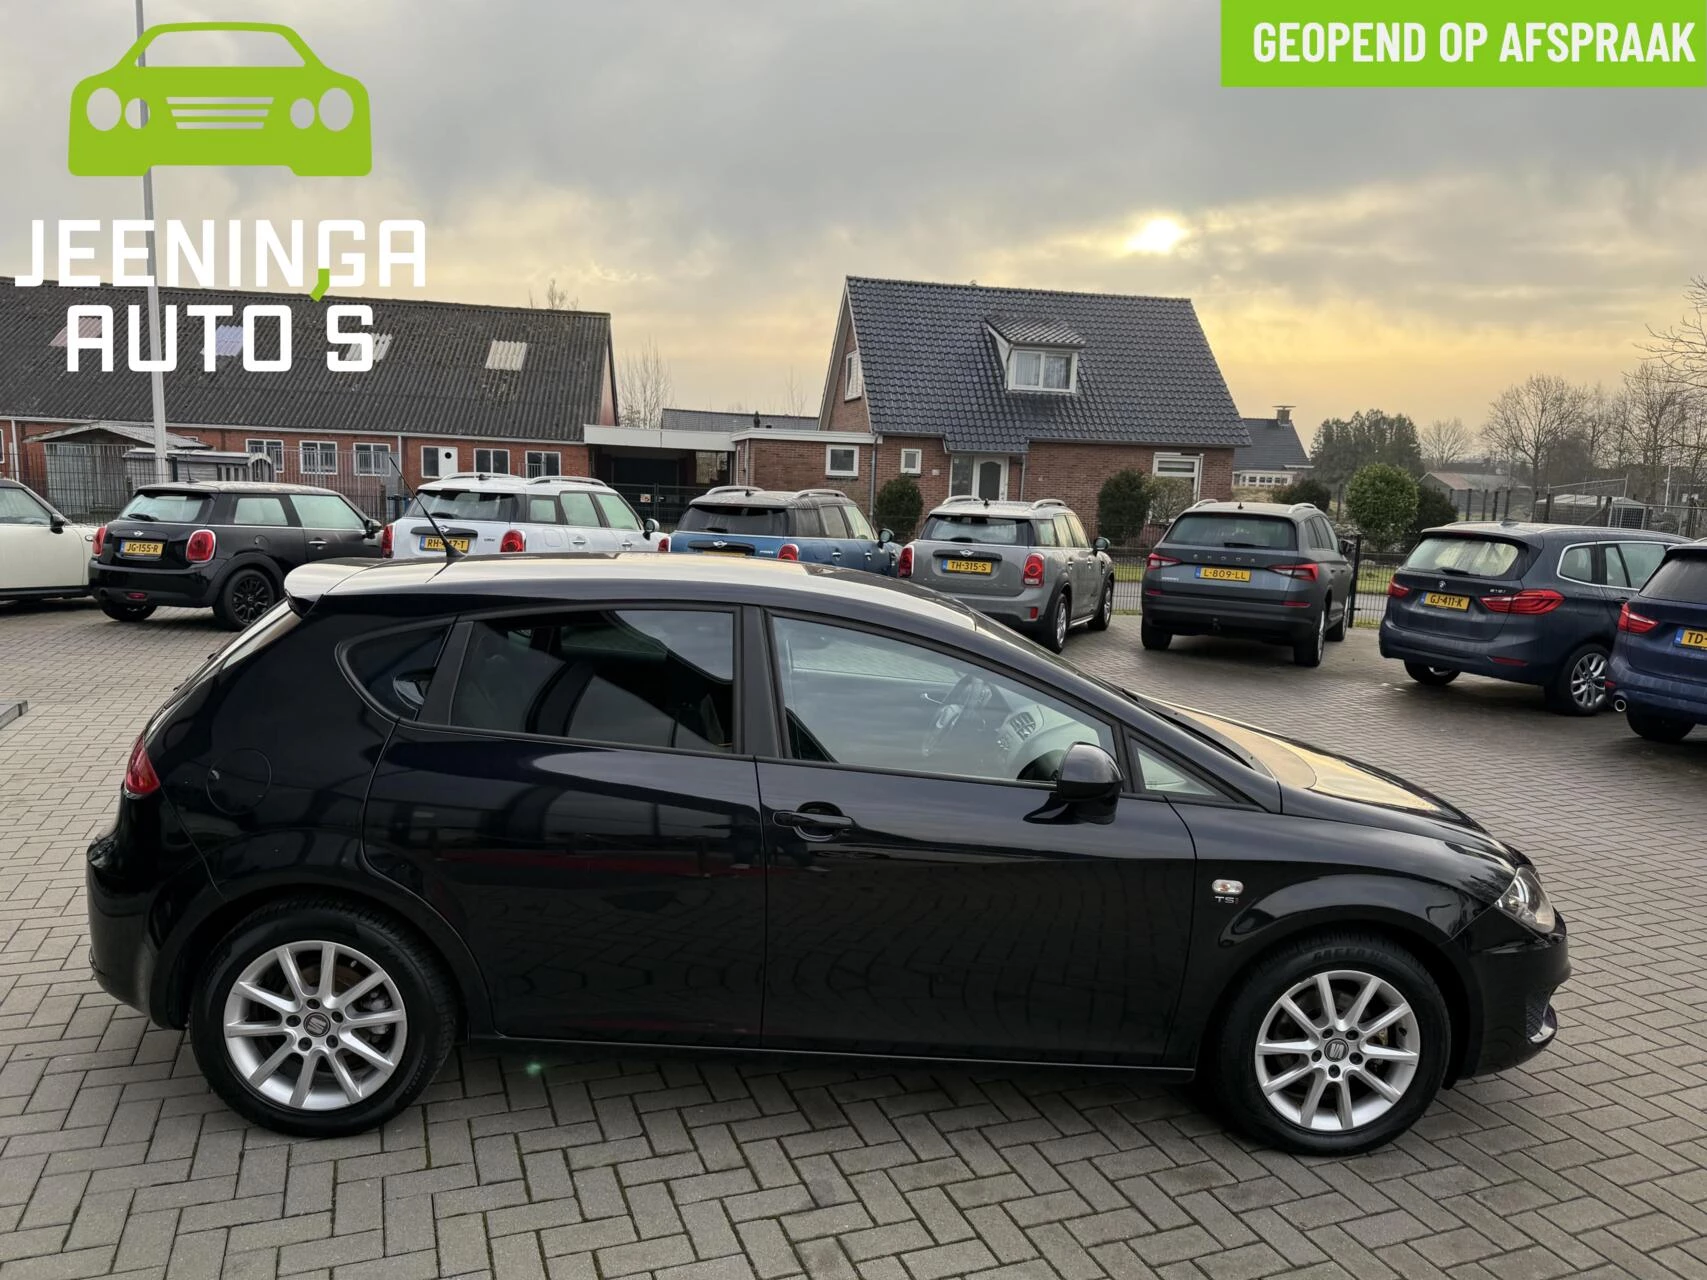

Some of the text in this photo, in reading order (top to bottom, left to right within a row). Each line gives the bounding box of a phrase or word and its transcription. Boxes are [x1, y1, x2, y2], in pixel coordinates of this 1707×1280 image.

[951, 561, 987, 571] TH-315-S
[1203, 569, 1246, 579] L-809-LL
[1430, 595, 1462, 607] GJ-411-K
